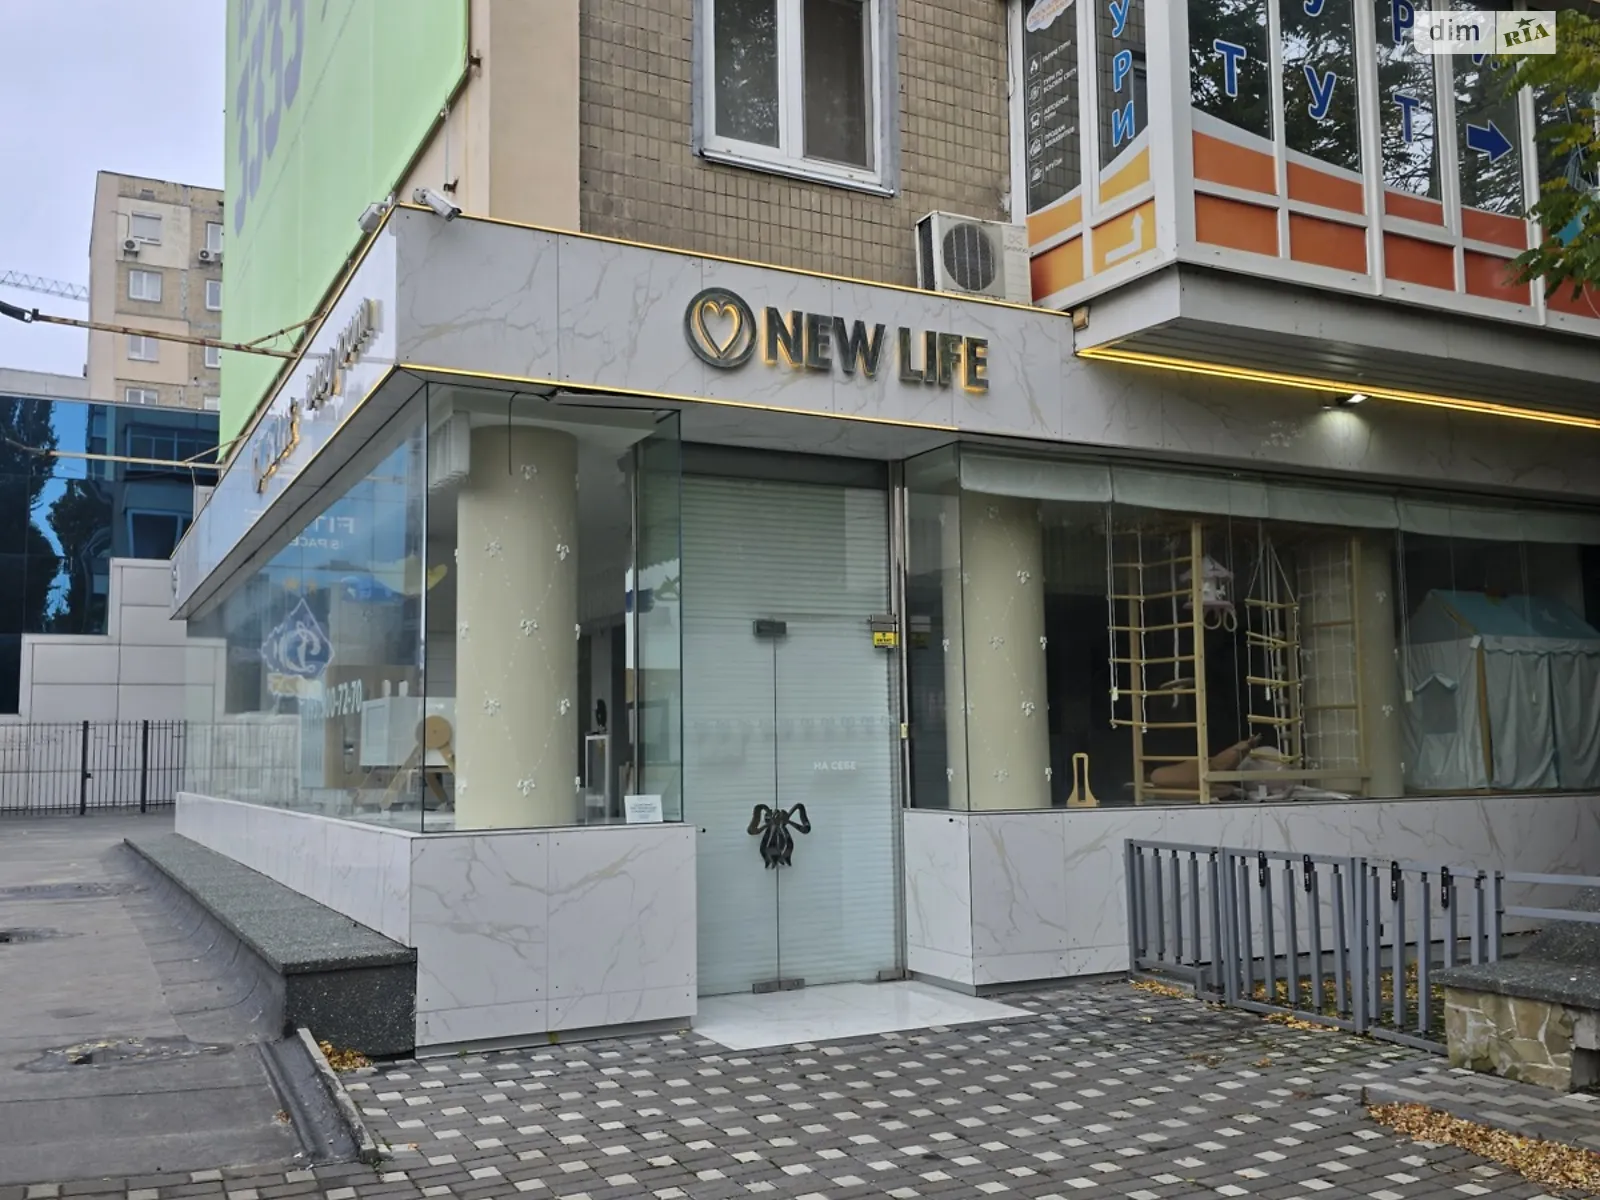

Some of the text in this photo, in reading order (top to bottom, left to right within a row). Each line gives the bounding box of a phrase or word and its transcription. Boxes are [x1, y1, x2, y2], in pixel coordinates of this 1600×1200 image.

[764, 306, 990, 394] NEW LIFE
[813, 760, 857, 771] НА СЕБЕ
